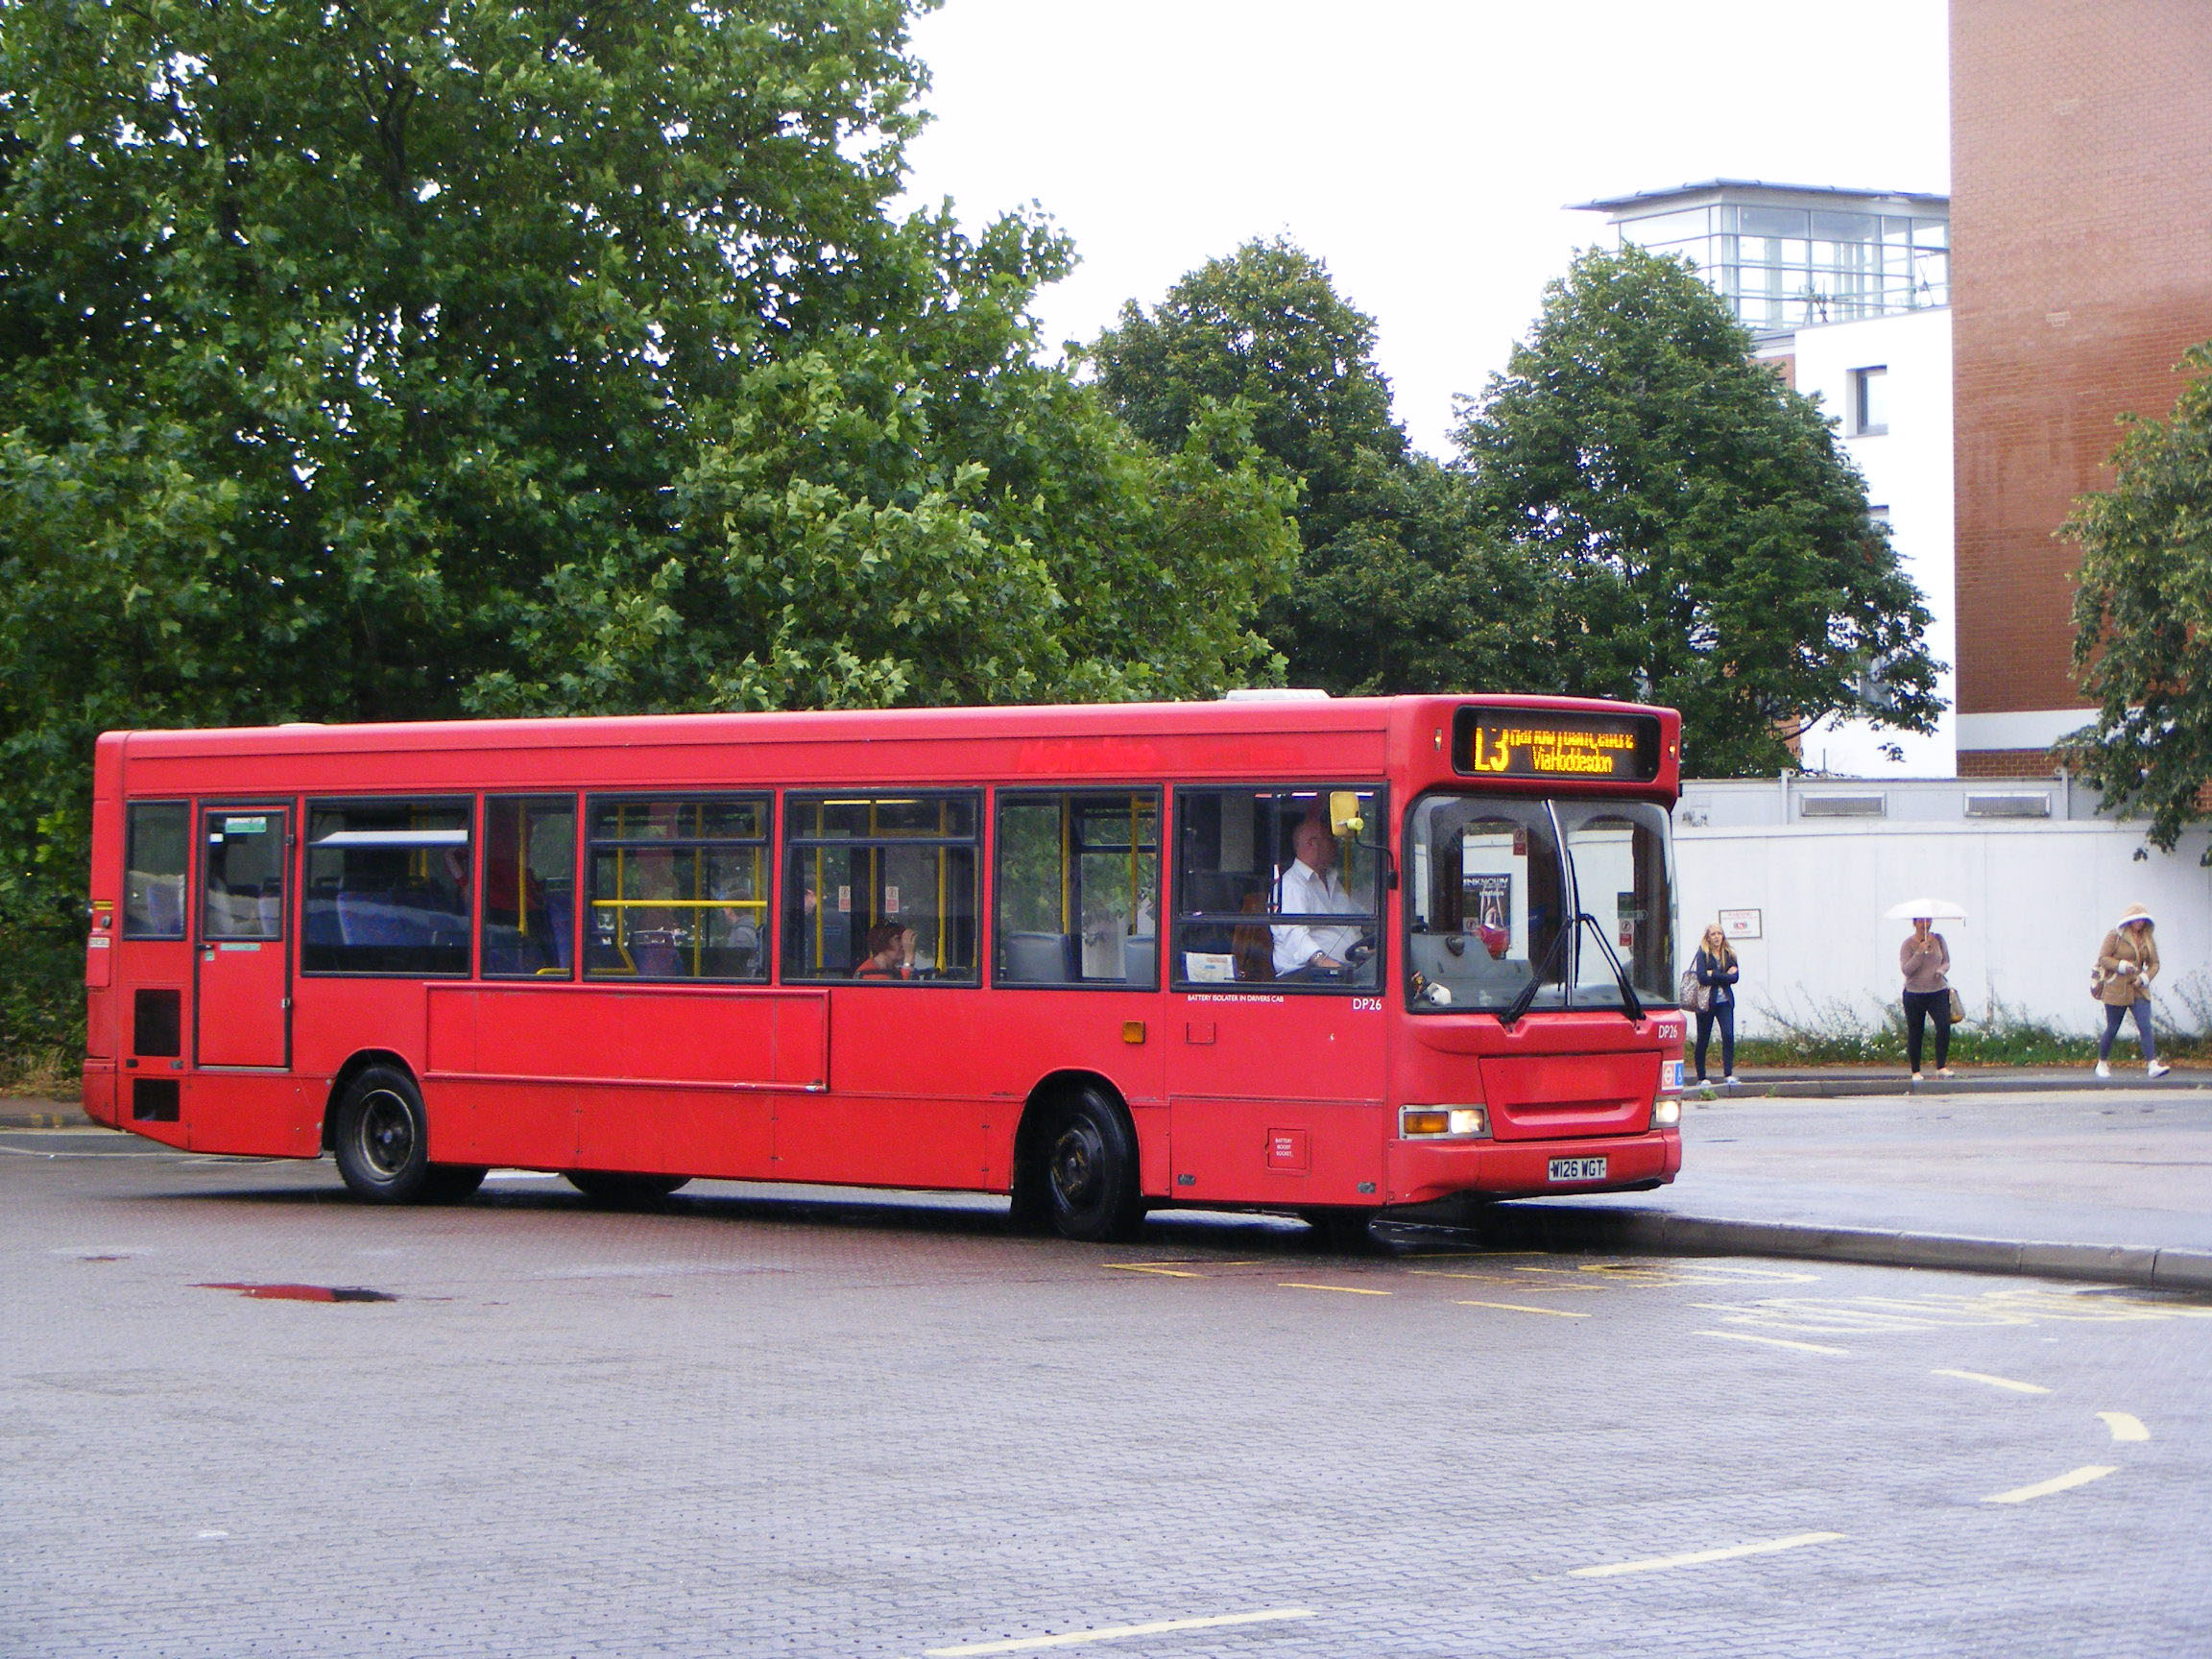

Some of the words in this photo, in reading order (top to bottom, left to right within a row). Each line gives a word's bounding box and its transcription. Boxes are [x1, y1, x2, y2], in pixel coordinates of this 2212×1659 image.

[1271, 995, 1285, 1003] CAB
[1352, 998, 1382, 1011] DP26
[1658, 1024, 1678, 1039] DP26
[1552, 1160, 1578, 1178] W126
[1581, 1159, 1604, 1177] WGT
